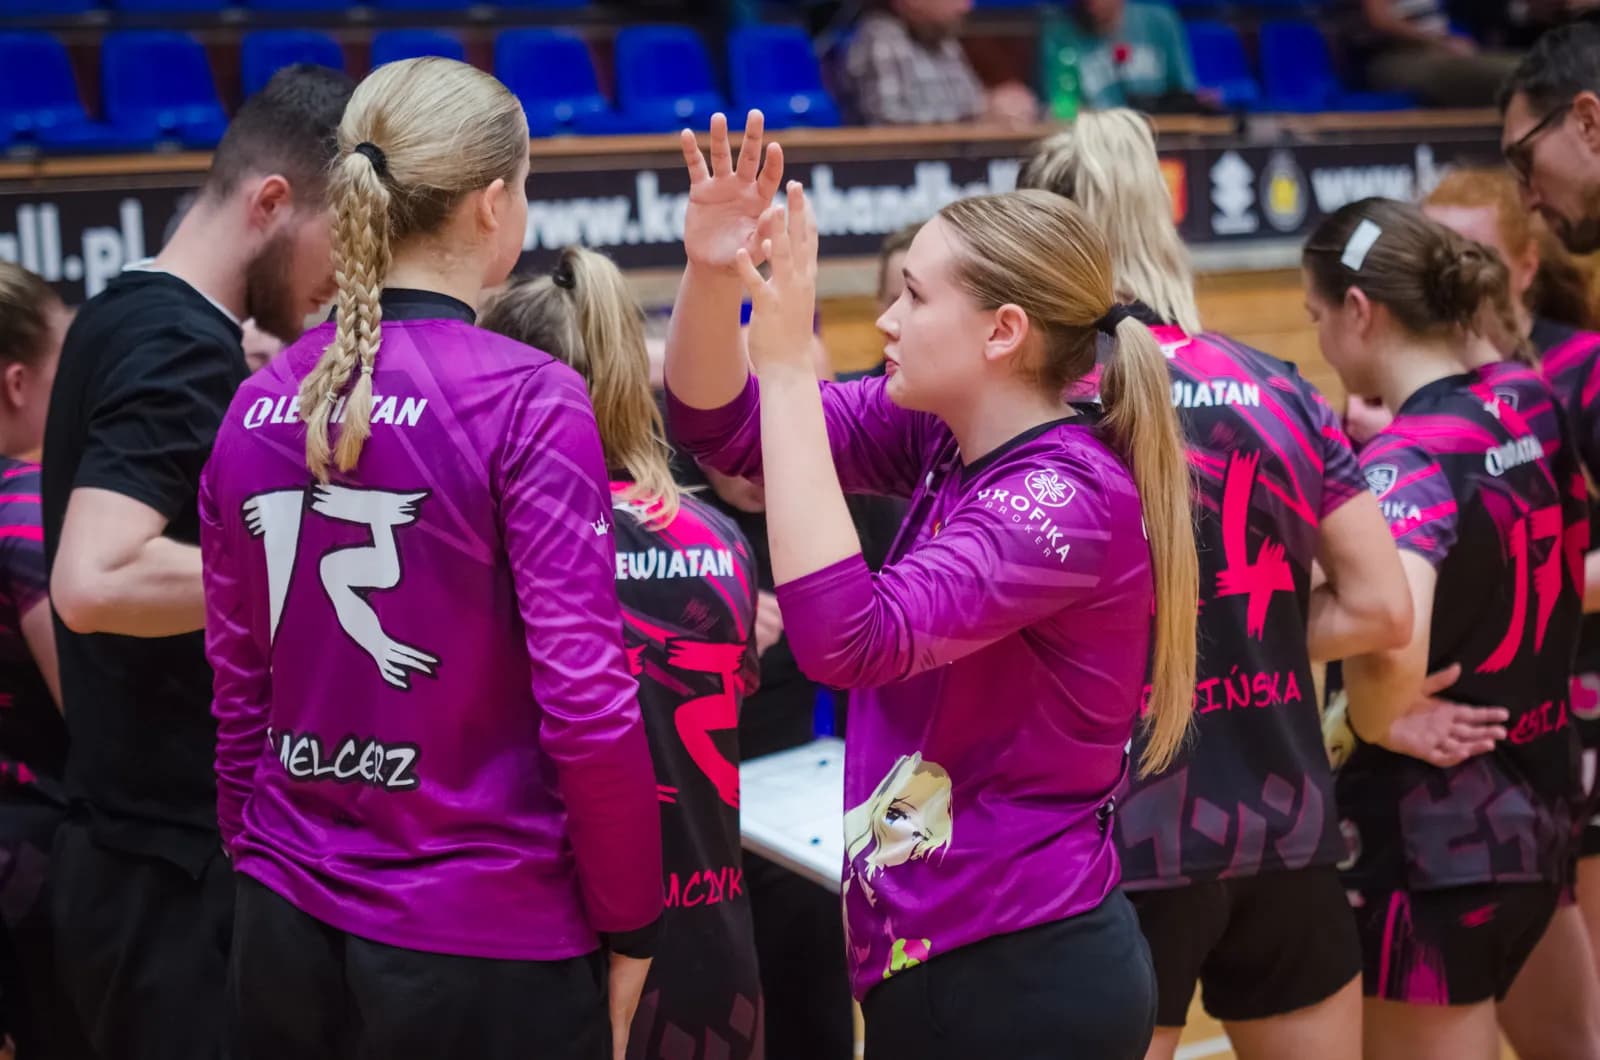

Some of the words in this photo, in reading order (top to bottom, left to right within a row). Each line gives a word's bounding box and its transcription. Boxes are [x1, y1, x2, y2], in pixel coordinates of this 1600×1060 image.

[615, 547, 734, 580] EWIATAN
[1196, 448, 1296, 641] 4
[1379, 501, 1422, 521] IKA
[243, 484, 437, 688] 12
[625, 639, 740, 808] 2
[1140, 664, 1302, 720] IŃSKA
